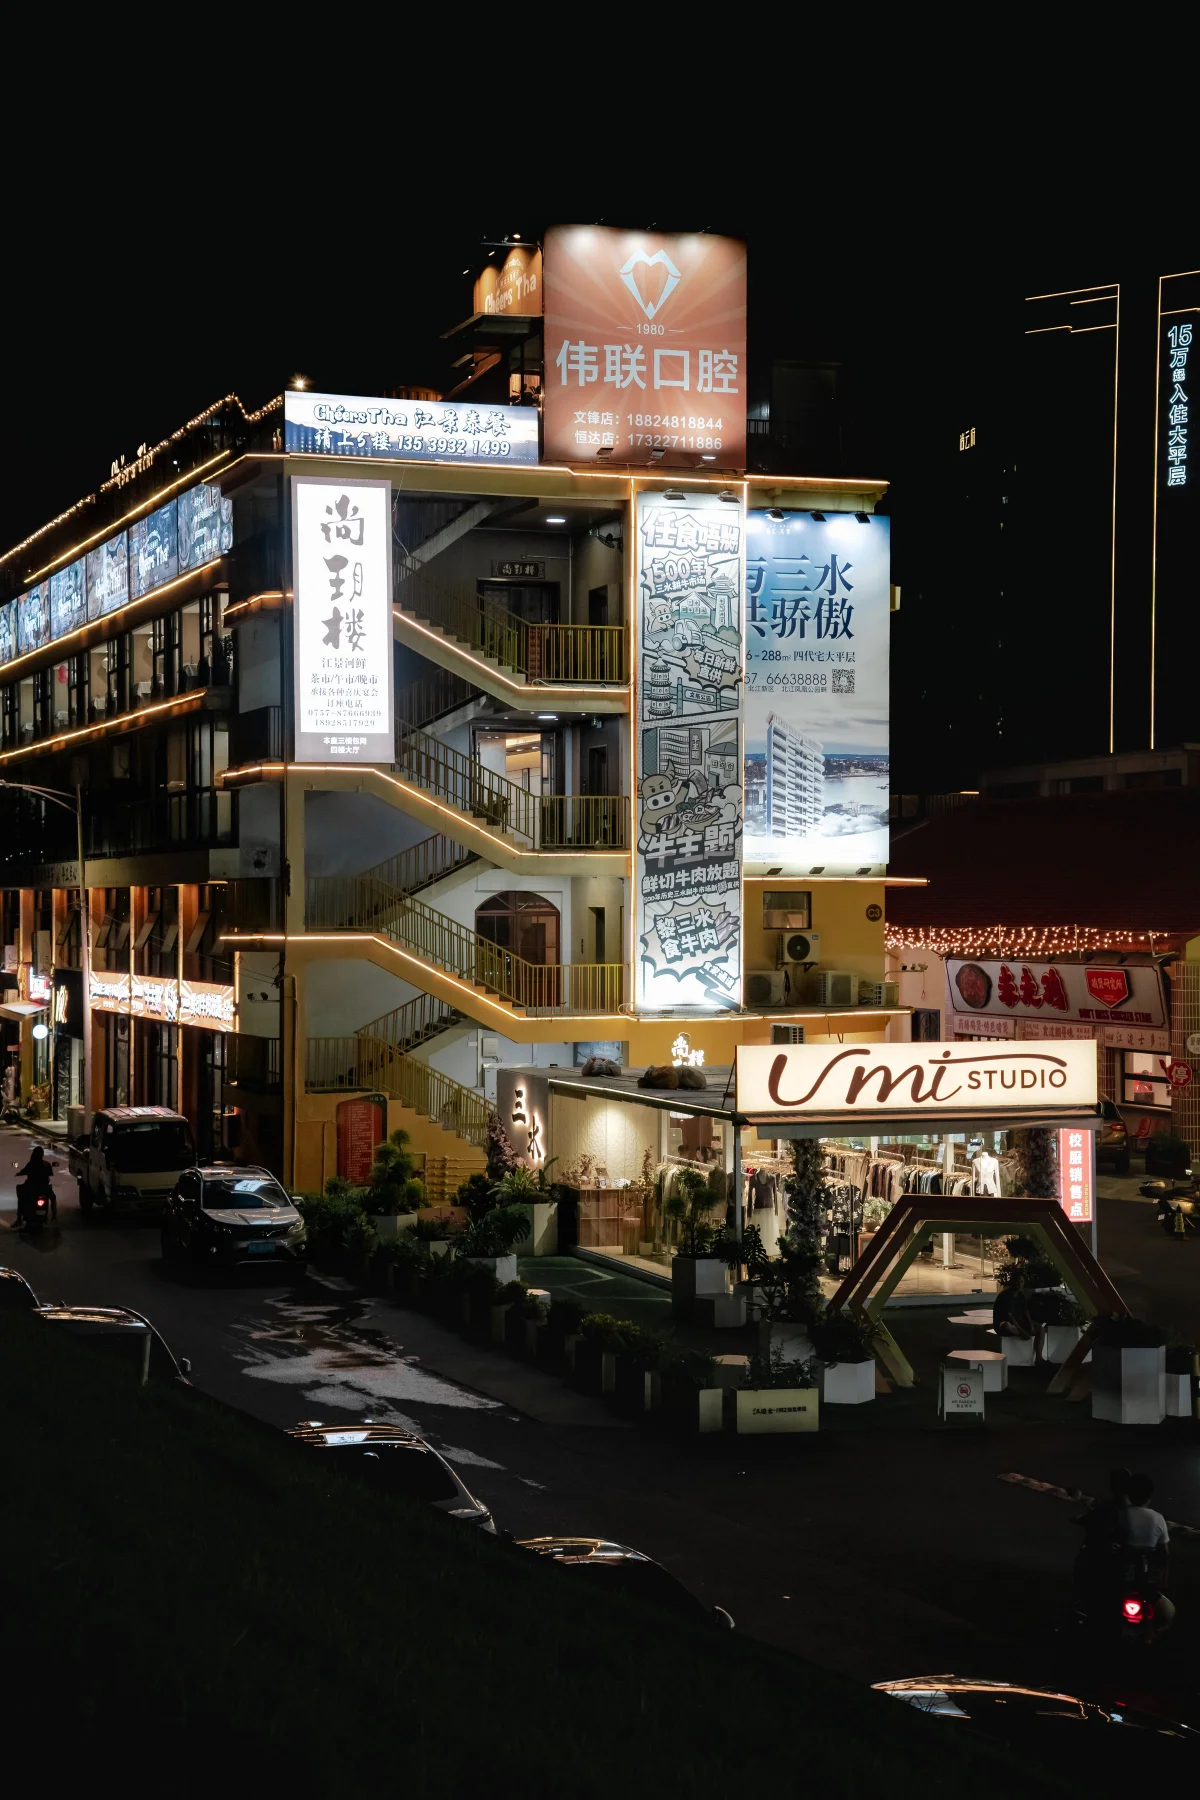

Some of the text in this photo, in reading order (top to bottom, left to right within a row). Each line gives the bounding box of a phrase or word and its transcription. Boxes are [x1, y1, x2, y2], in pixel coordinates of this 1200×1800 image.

[636, 323, 665, 335] 1980
[555, 339, 739, 393] 伟联口腔
[626, 413, 723, 430] 18824818844
[398, 434, 423, 451] 135
[427, 438, 467, 454] 3932
[472, 439, 511, 456] 1499
[626, 433, 723, 449] 17322711886
[651, 558, 706, 584] 500年
[643, 822, 738, 868] 牛主题
[642, 861, 740, 894] 鲜切牛肉放题
[867, 907, 880, 918] C3
[661, 928, 719, 959] 食牛肉
[967, 1069, 1067, 1089] STUDIO
[1171, 1065, 1189, 1084] 停
[1068, 1132, 1083, 1217] 校服销售点
